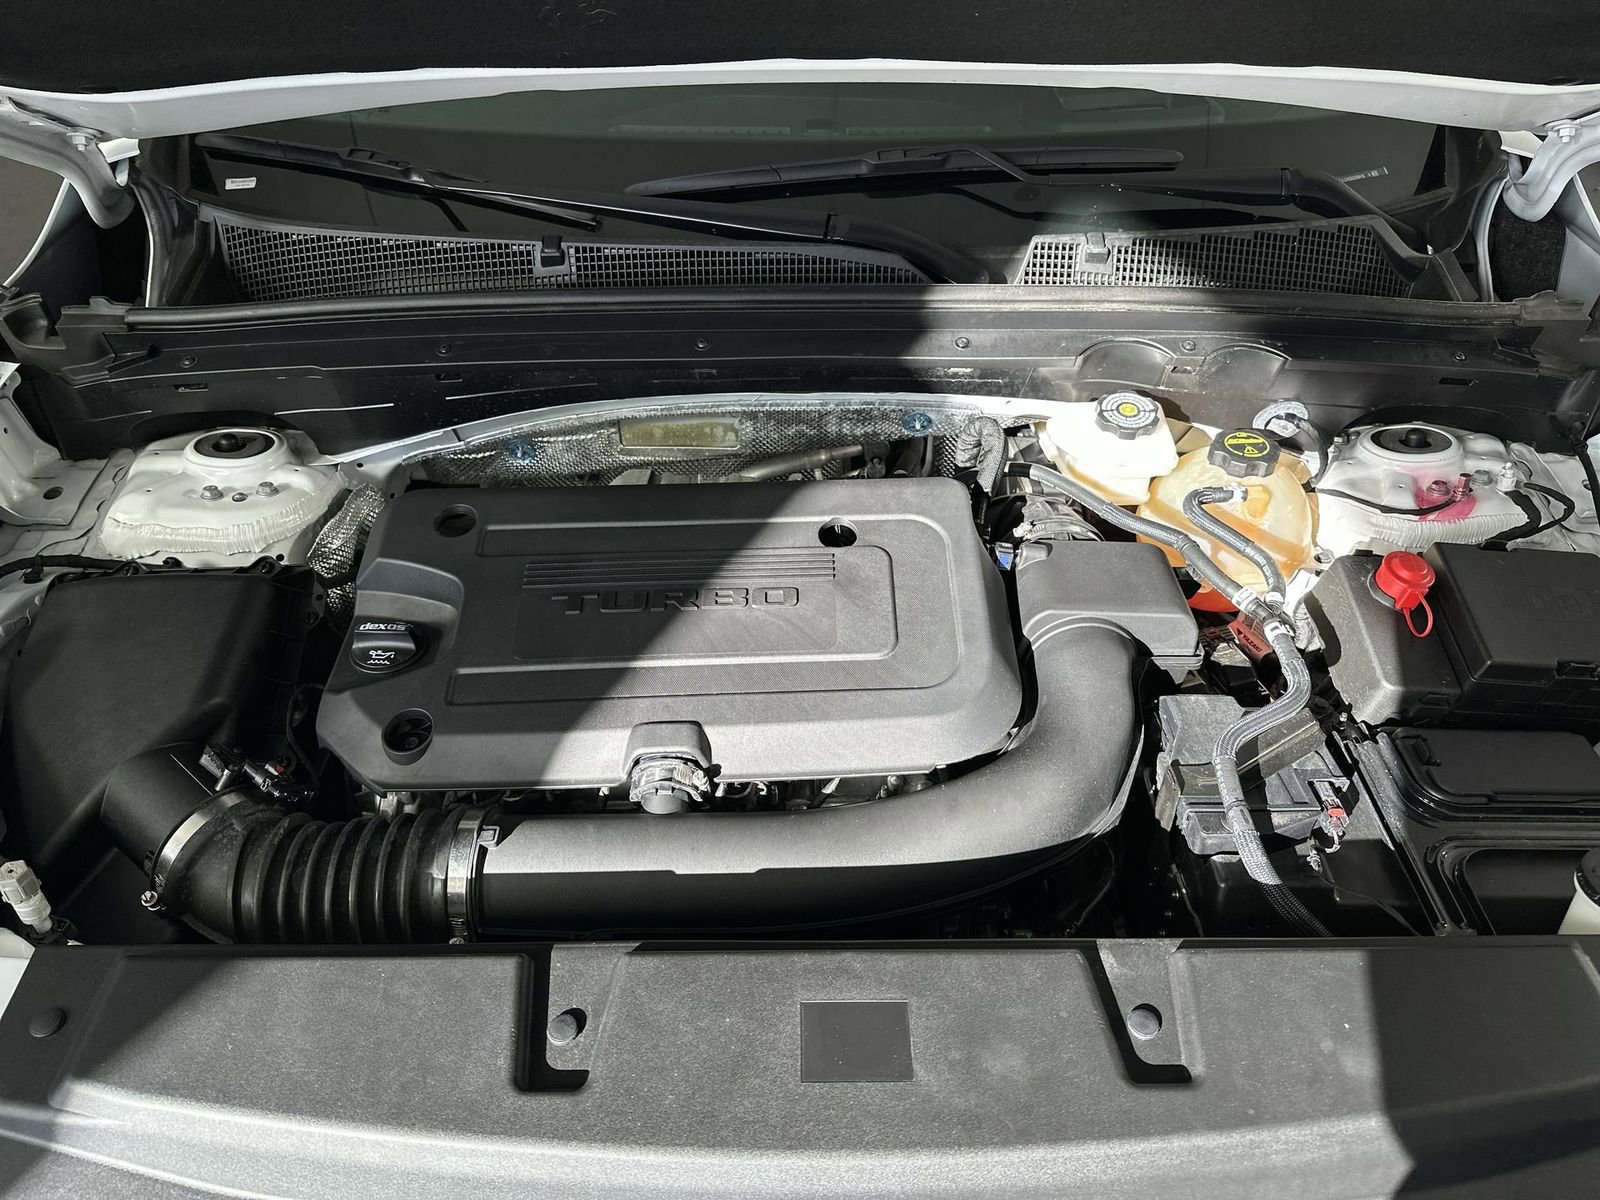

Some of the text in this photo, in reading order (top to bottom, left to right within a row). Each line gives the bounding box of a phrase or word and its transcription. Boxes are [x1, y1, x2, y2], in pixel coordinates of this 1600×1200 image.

[551, 586, 800, 615] TURBO
[359, 622, 407, 631] dexos
[1242, 633, 1263, 653] YAZAKI
